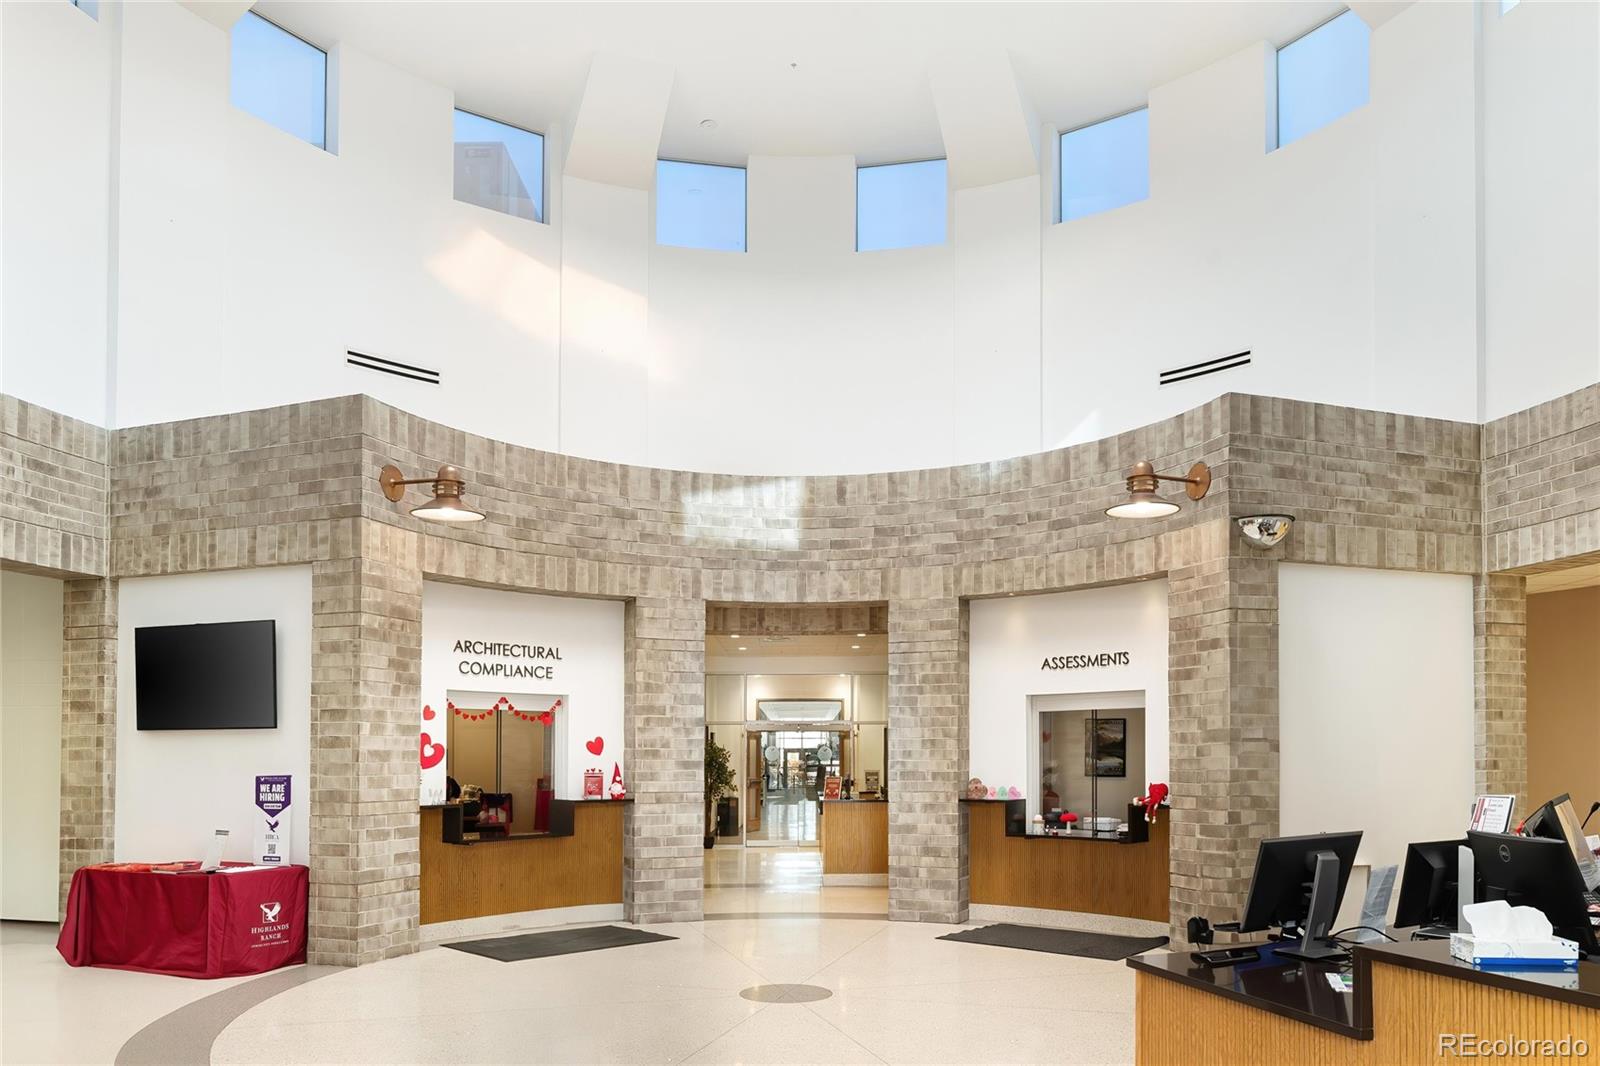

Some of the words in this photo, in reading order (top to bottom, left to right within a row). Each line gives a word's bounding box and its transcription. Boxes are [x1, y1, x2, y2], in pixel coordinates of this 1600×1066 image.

[453, 639, 563, 660] ARCHITECTURAL
[1041, 651, 1130, 671] ASSESSMENTS
[458, 660, 553, 680] COMPLIANCE
[259, 784, 271, 793] WE
[271, 784, 285, 793] ARE
[259, 792, 285, 802] HIRING
[251, 923, 290, 934] HIGHLANDS
